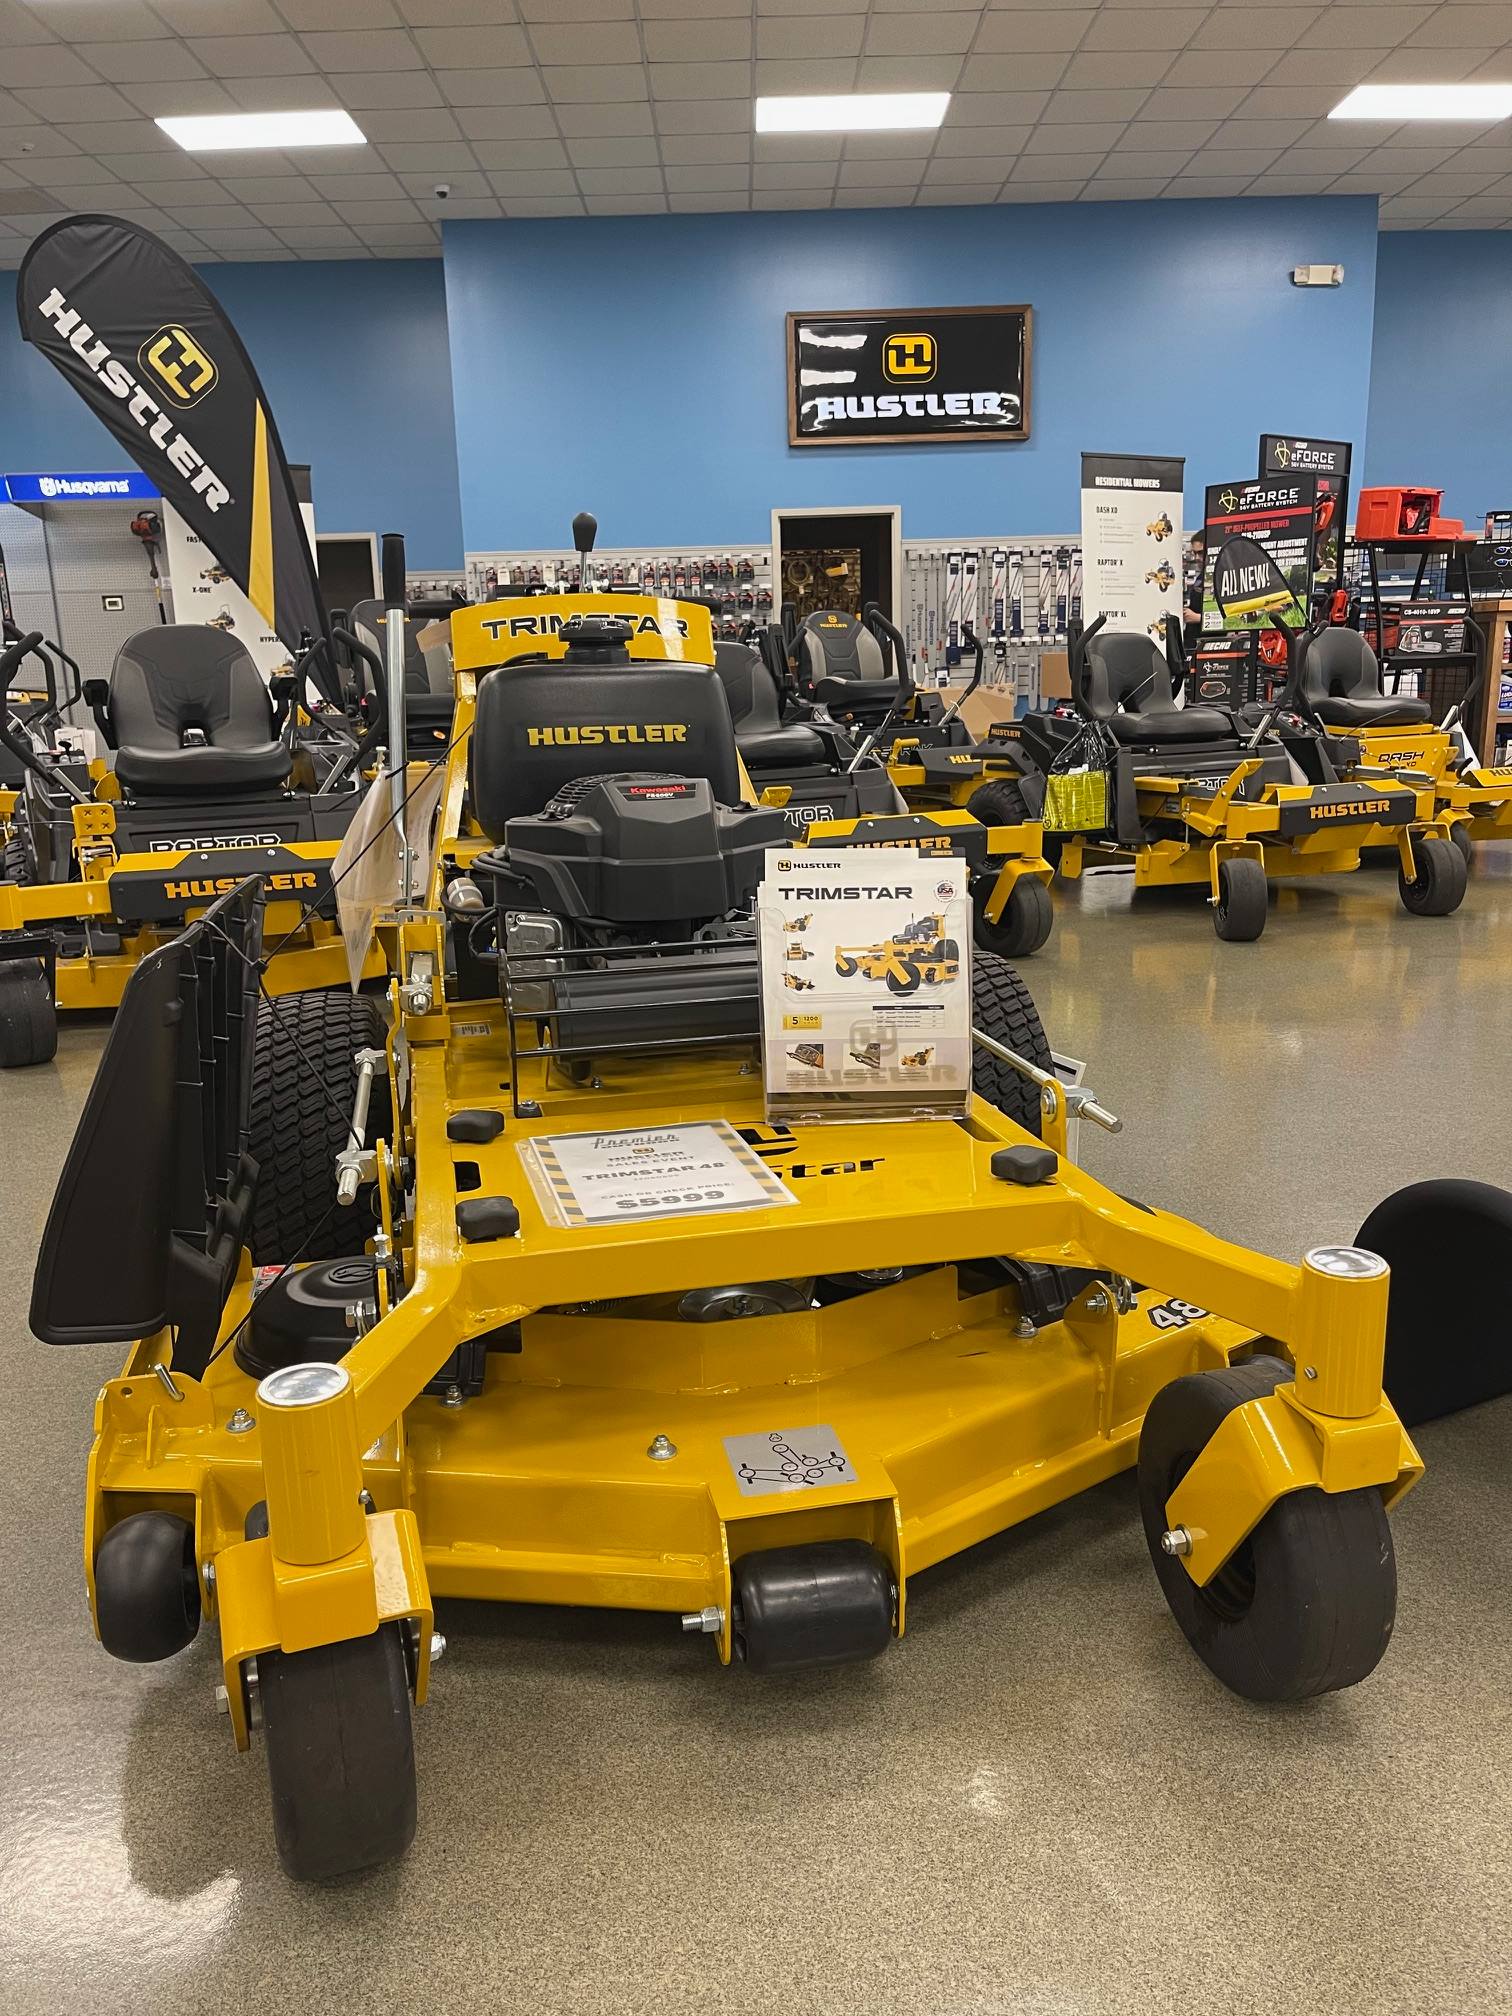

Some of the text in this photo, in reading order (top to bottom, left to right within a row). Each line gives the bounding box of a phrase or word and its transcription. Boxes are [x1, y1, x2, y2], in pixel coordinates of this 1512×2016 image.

[38, 288, 232, 513] HUSTLER
[815, 391, 1002, 420] HUSTLER
[1291, 450, 1337, 464] eFORCE
[55, 479, 129, 495] Husqvarna
[1095, 476, 1160, 488] RESIDENTIAL MOWERS
[1240, 488, 1299, 505] eFORCE
[1096, 506, 1110, 514] DASH
[1277, 538, 1308, 549] ADJUSTMENT
[1221, 562, 1271, 598] ALL NEW!
[1204, 612, 1211, 620] 5
[1204, 621, 1211, 629] 2
[527, 724, 688, 746] HUSTLER
[991, 728, 1021, 738] HUSTLER
[1377, 751, 1425, 764] DASH
[630, 785, 686, 795] Kawasaki
[1310, 800, 1390, 819] HUSTLER
[793, 862, 842, 870] HUSTLER
[164, 872, 317, 899] HUSER
[937, 884, 954, 895] USA
[778, 886, 913, 900] TRIMSTAR
[792, 1016, 799, 1025] 5
[591, 1133, 678, 1149] Premier
[606, 1155, 695, 1168] SALES EVENT
[582, 1165, 697, 1181] TRIMSTAR
[601, 1191, 633, 1200] CASH
[656, 1186, 694, 1195] CHECK
[615, 1190, 725, 1209] $5999
[1148, 1298, 1207, 1329] 48
